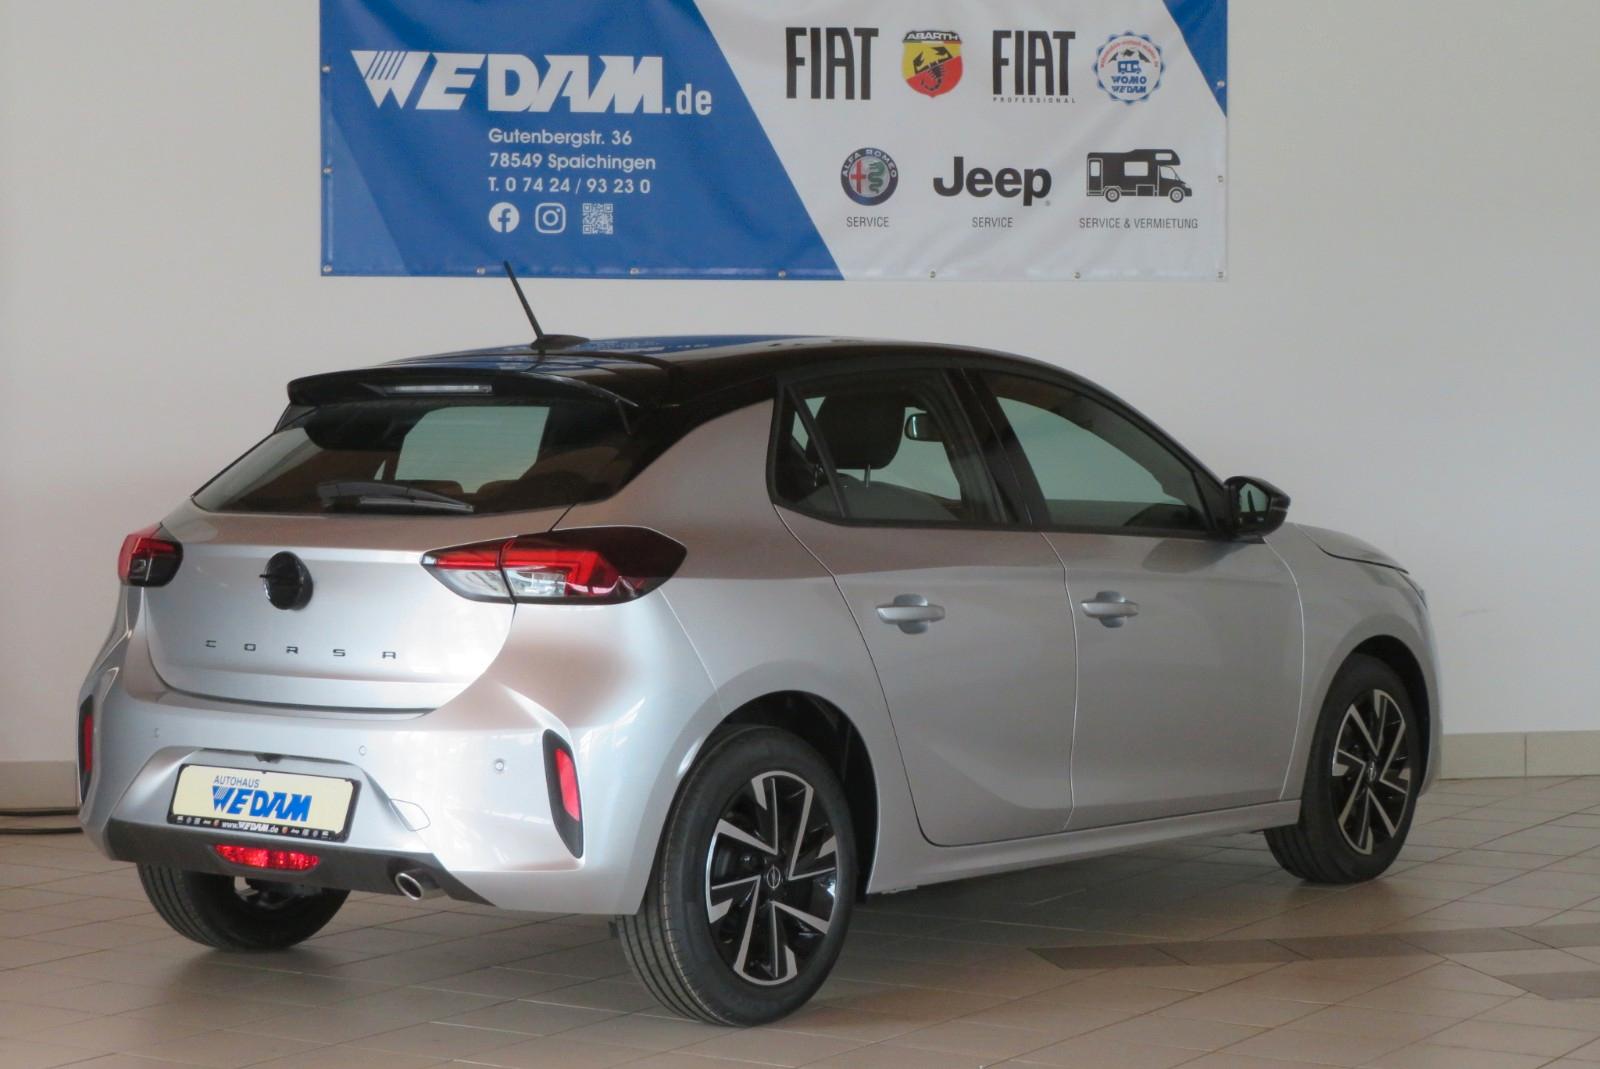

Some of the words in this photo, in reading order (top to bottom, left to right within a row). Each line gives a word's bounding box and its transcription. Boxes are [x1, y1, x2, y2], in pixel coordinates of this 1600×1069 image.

[906, 31, 960, 41] ABARTH
[785, 27, 879, 100] FIAT
[993, 30, 1076, 96] FIAT
[1111, 75, 1147, 85] WOMO
[1111, 85, 1147, 94] WEDAM
[488, 128, 605, 148] Gutenbergstr.
[611, 130, 632, 145] 36
[490, 152, 543, 168] 78549
[547, 153, 656, 173] Spaichingen
[842, 152, 861, 177] ALFA
[865, 149, 897, 178] ROMEO
[488, 176, 500, 192] T.
[505, 177, 517, 192] 0
[522, 177, 543, 192] 74
[549, 177, 570, 193] 24
[586, 178, 607, 193] 93
[613, 179, 634, 194] 23
[639, 179, 651, 194] 0
[933, 156, 1052, 207] Jeep
[846, 216, 889, 228] SERVICE
[971, 216, 1014, 228] SERVICE
[1079, 217, 1122, 229] SERVICE
[1123, 218, 1131, 229] &
[1133, 218, 1199, 229] VERMIETUNG
[205, 639, 397, 659] CORSA
[213, 775, 260, 788] AUTOHAUS
[212, 785, 312, 822] WEDAM
[222, 820, 279, 834] www.WEDAM.de
